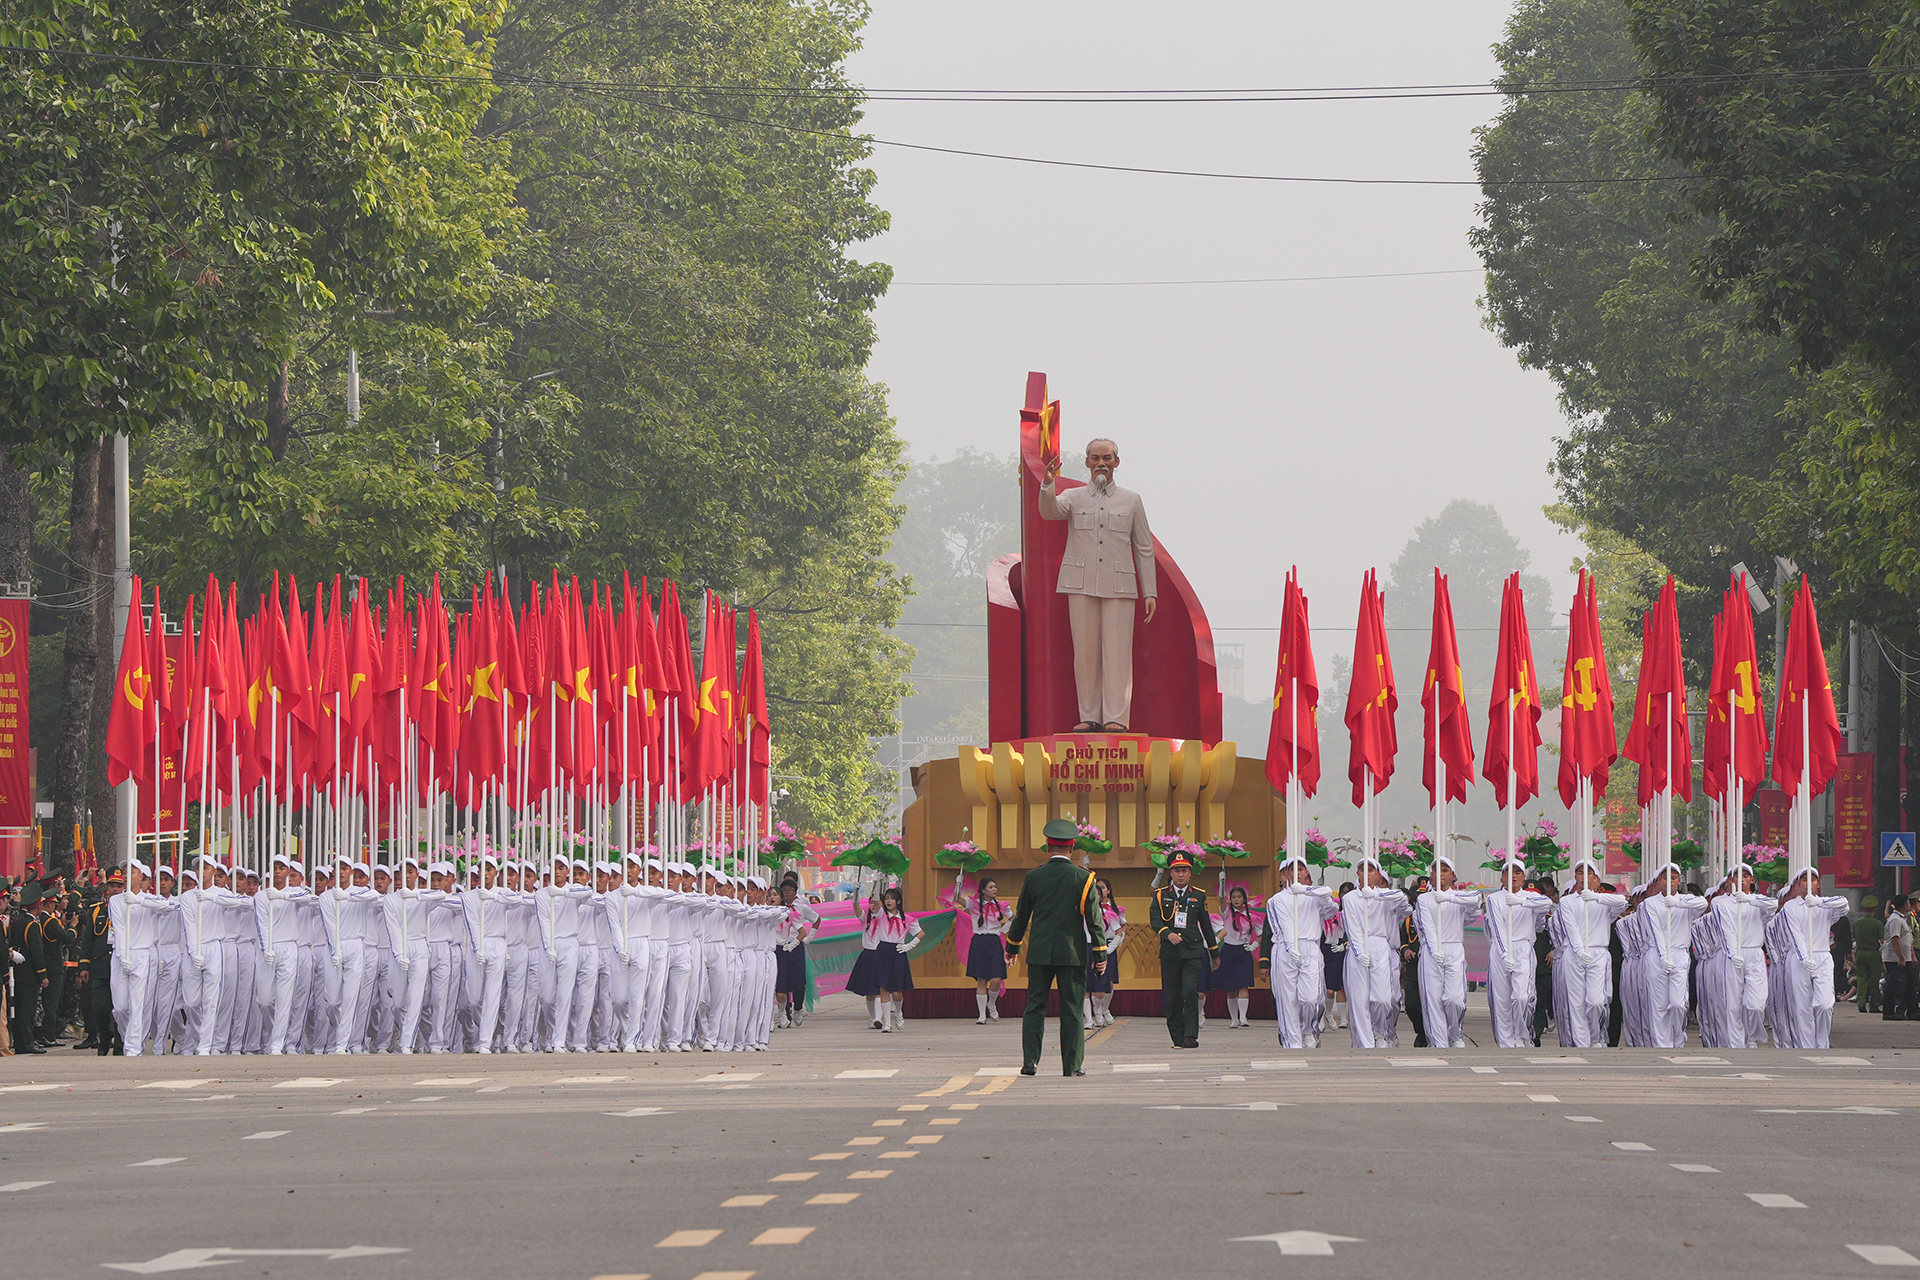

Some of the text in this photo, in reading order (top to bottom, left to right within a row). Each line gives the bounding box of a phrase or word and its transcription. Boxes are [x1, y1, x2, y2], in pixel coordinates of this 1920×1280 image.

[3, 733, 14, 743] NAM
[1066, 744, 1128, 761] CHỦ TỊCH
[1050, 758, 1144, 779] HỒ CHÍ MINH
[1059, 782, 1092, 792] (1890
[1102, 782, 1135, 792] 1969)
